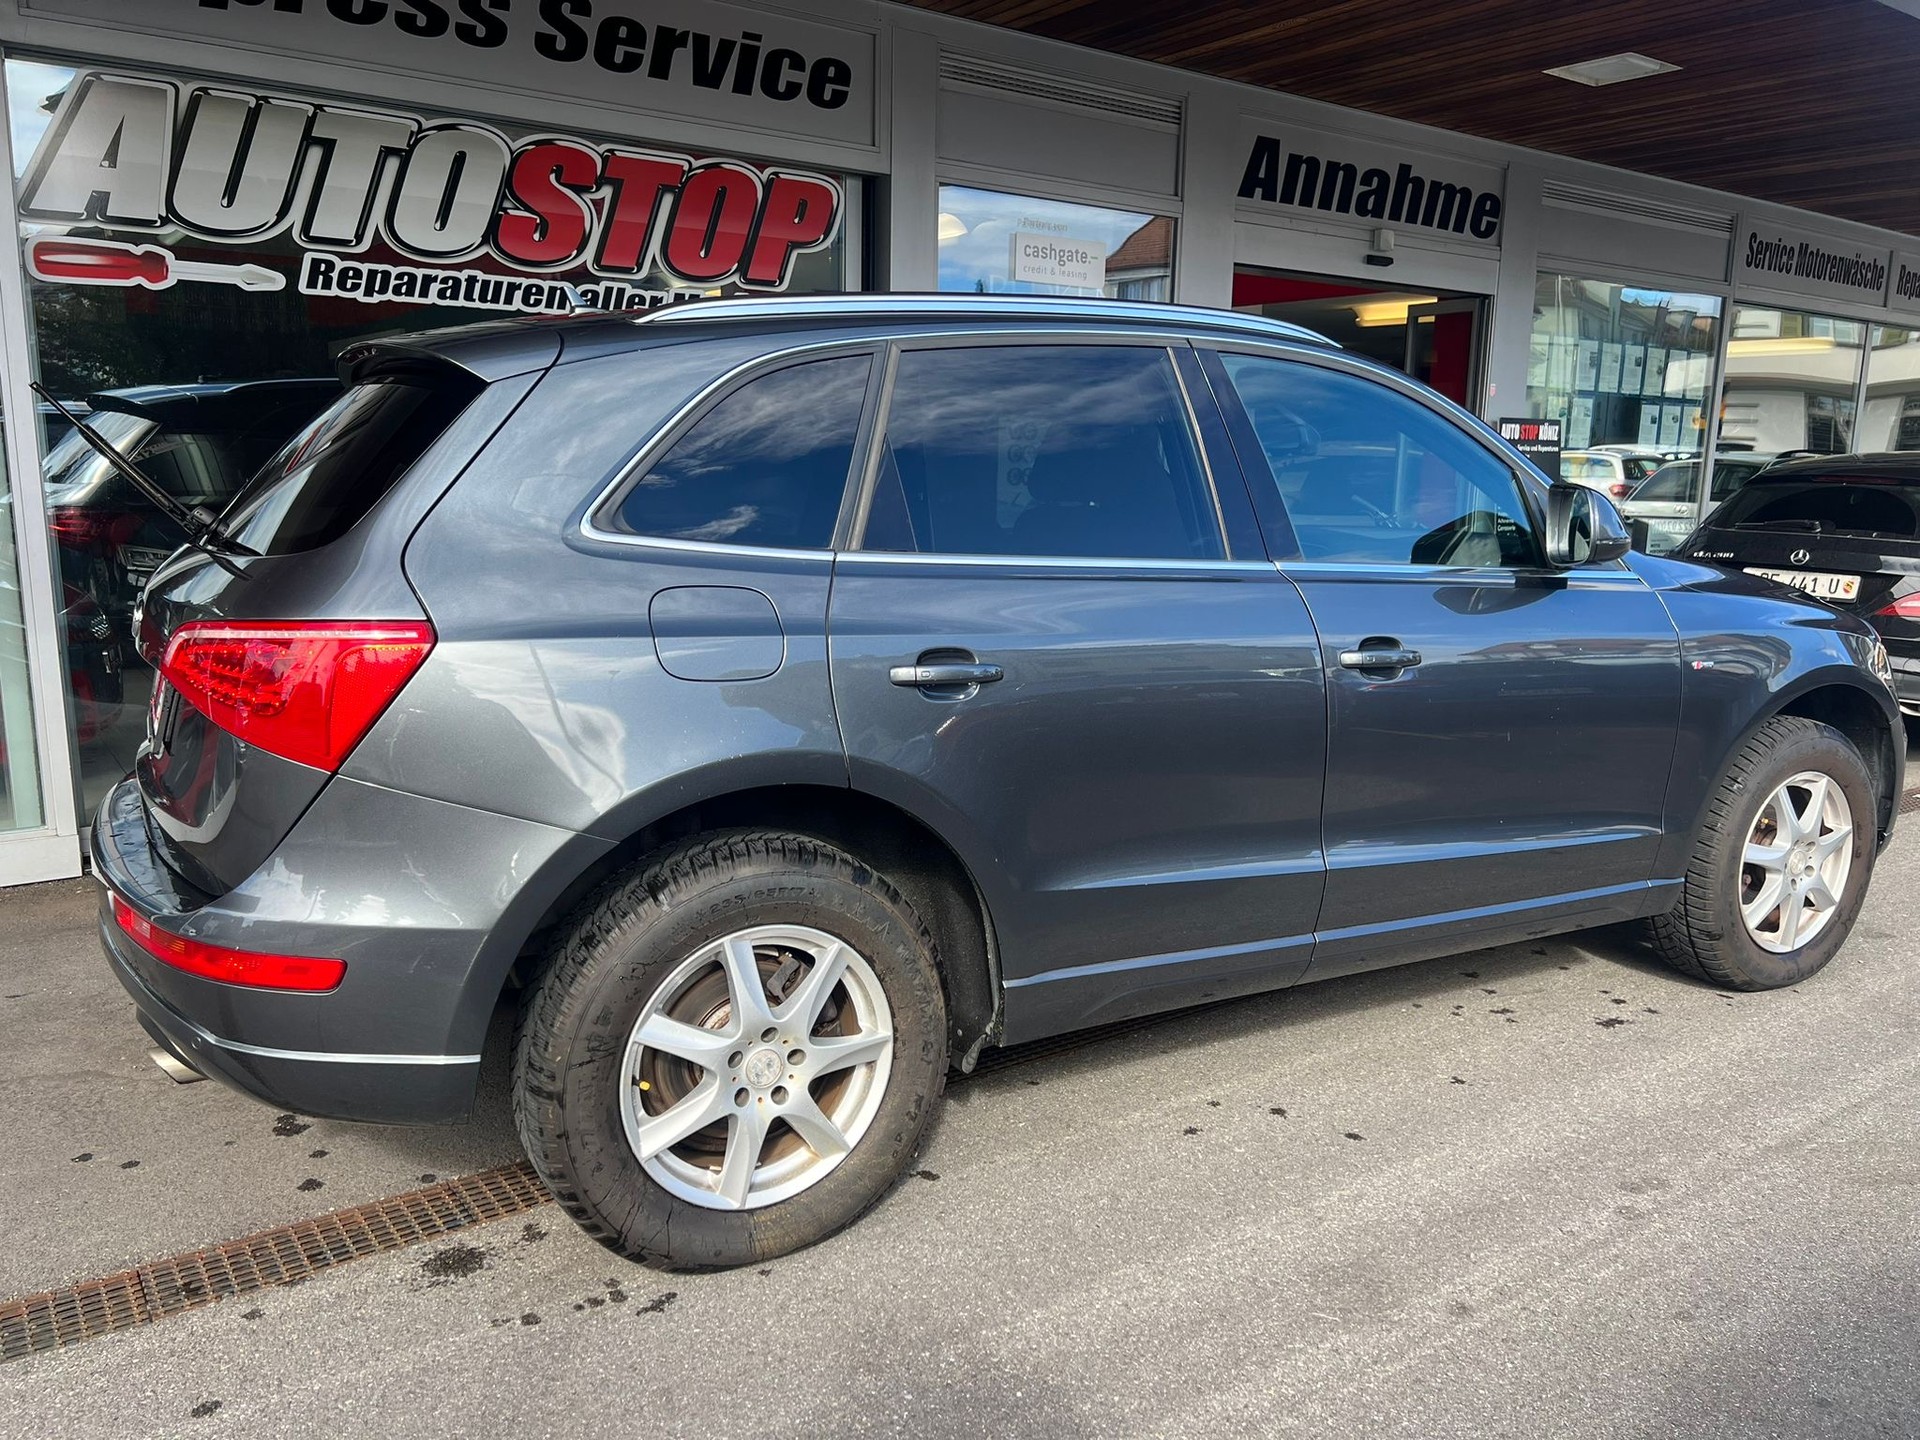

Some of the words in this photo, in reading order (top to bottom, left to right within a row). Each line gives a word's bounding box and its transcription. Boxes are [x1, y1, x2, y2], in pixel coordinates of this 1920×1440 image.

[534, 0, 853, 110] Service
[1237, 135, 1500, 240] Annahme
[304, 257, 577, 310] Reparaturen
[1023, 264, 1047, 275] credit
[1050, 268, 1056, 276] &
[1058, 268, 1088, 280] leasing
[1746, 232, 1795, 275] Service
[1794, 242, 1885, 292] Motorenwäsche
[1501, 423, 1520, 440] AUTO
[1520, 424, 1539, 440] STOP
[1828, 578, 1840, 595] U
